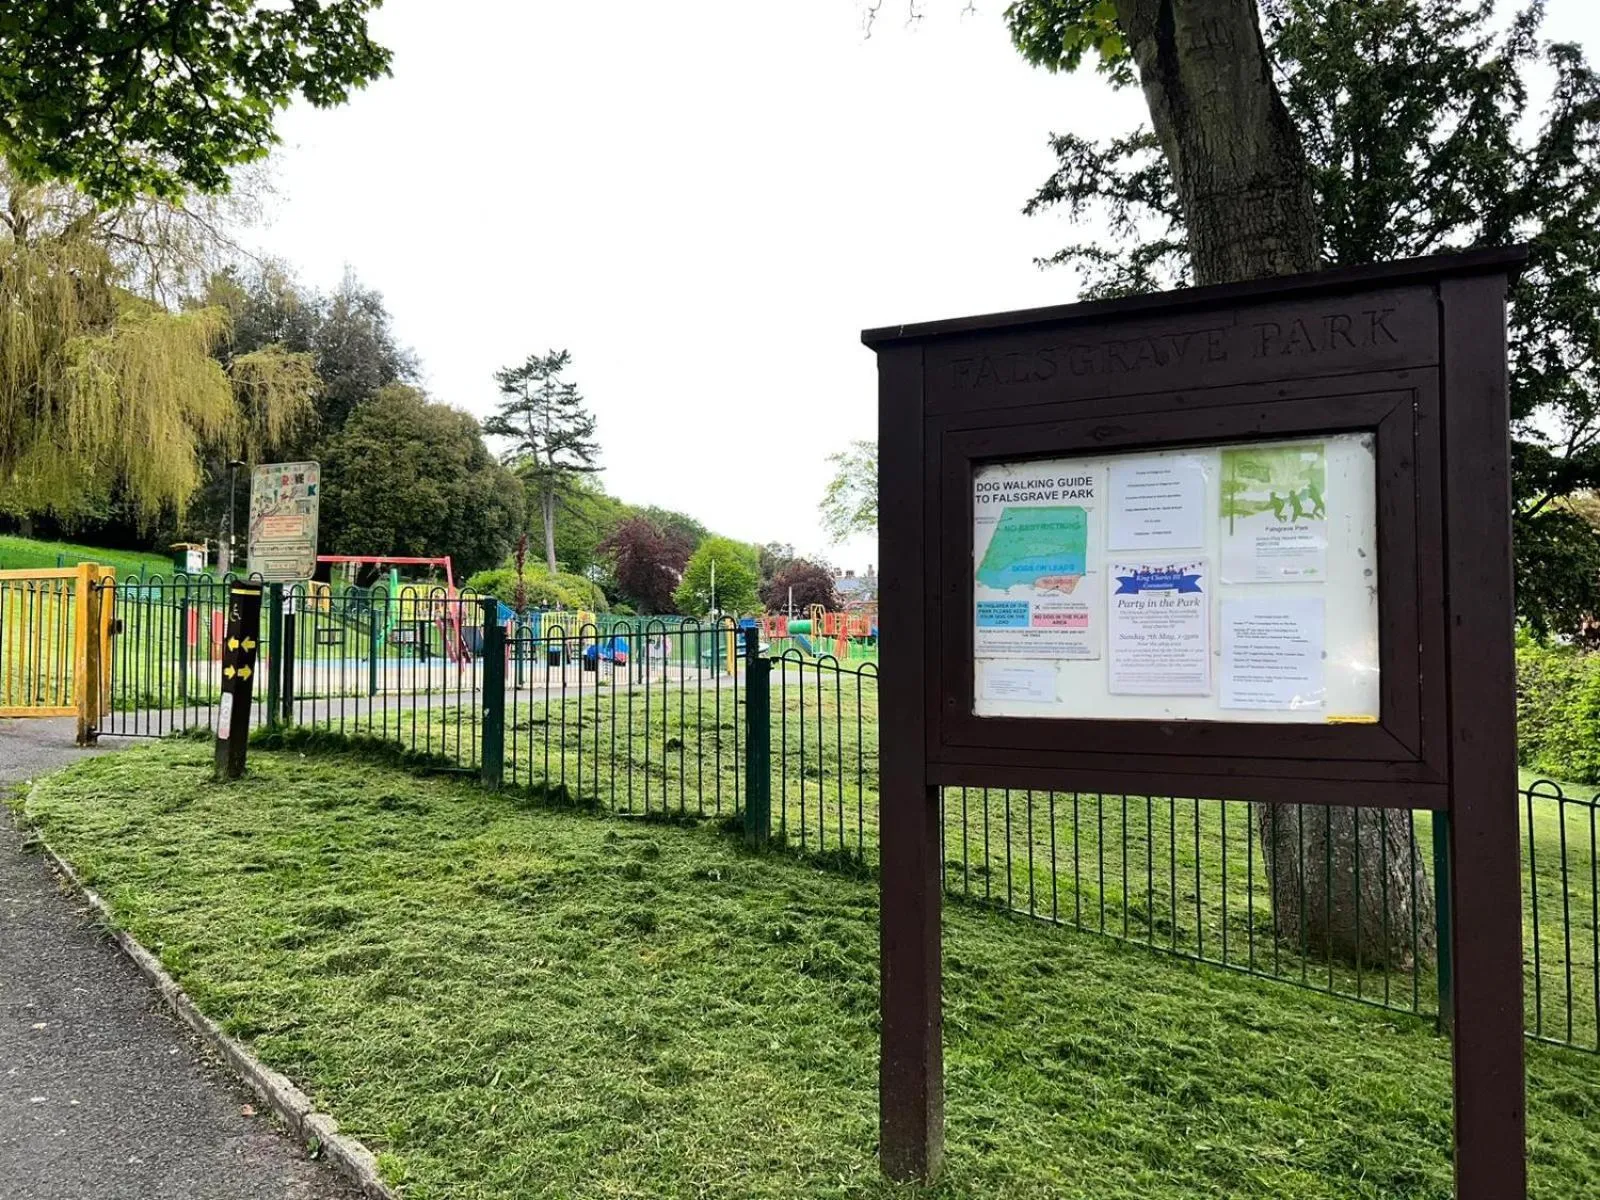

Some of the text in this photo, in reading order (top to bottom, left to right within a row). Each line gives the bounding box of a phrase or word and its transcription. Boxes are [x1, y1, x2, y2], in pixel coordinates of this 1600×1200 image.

[951, 308, 1399, 389] FALSGRAVE PARK
[976, 476, 1094, 492] DOG WALKING GUIDE
[975, 488, 1095, 504] TO FALSGRAVE PARK
[1118, 597, 1200, 609] Party in the Park
